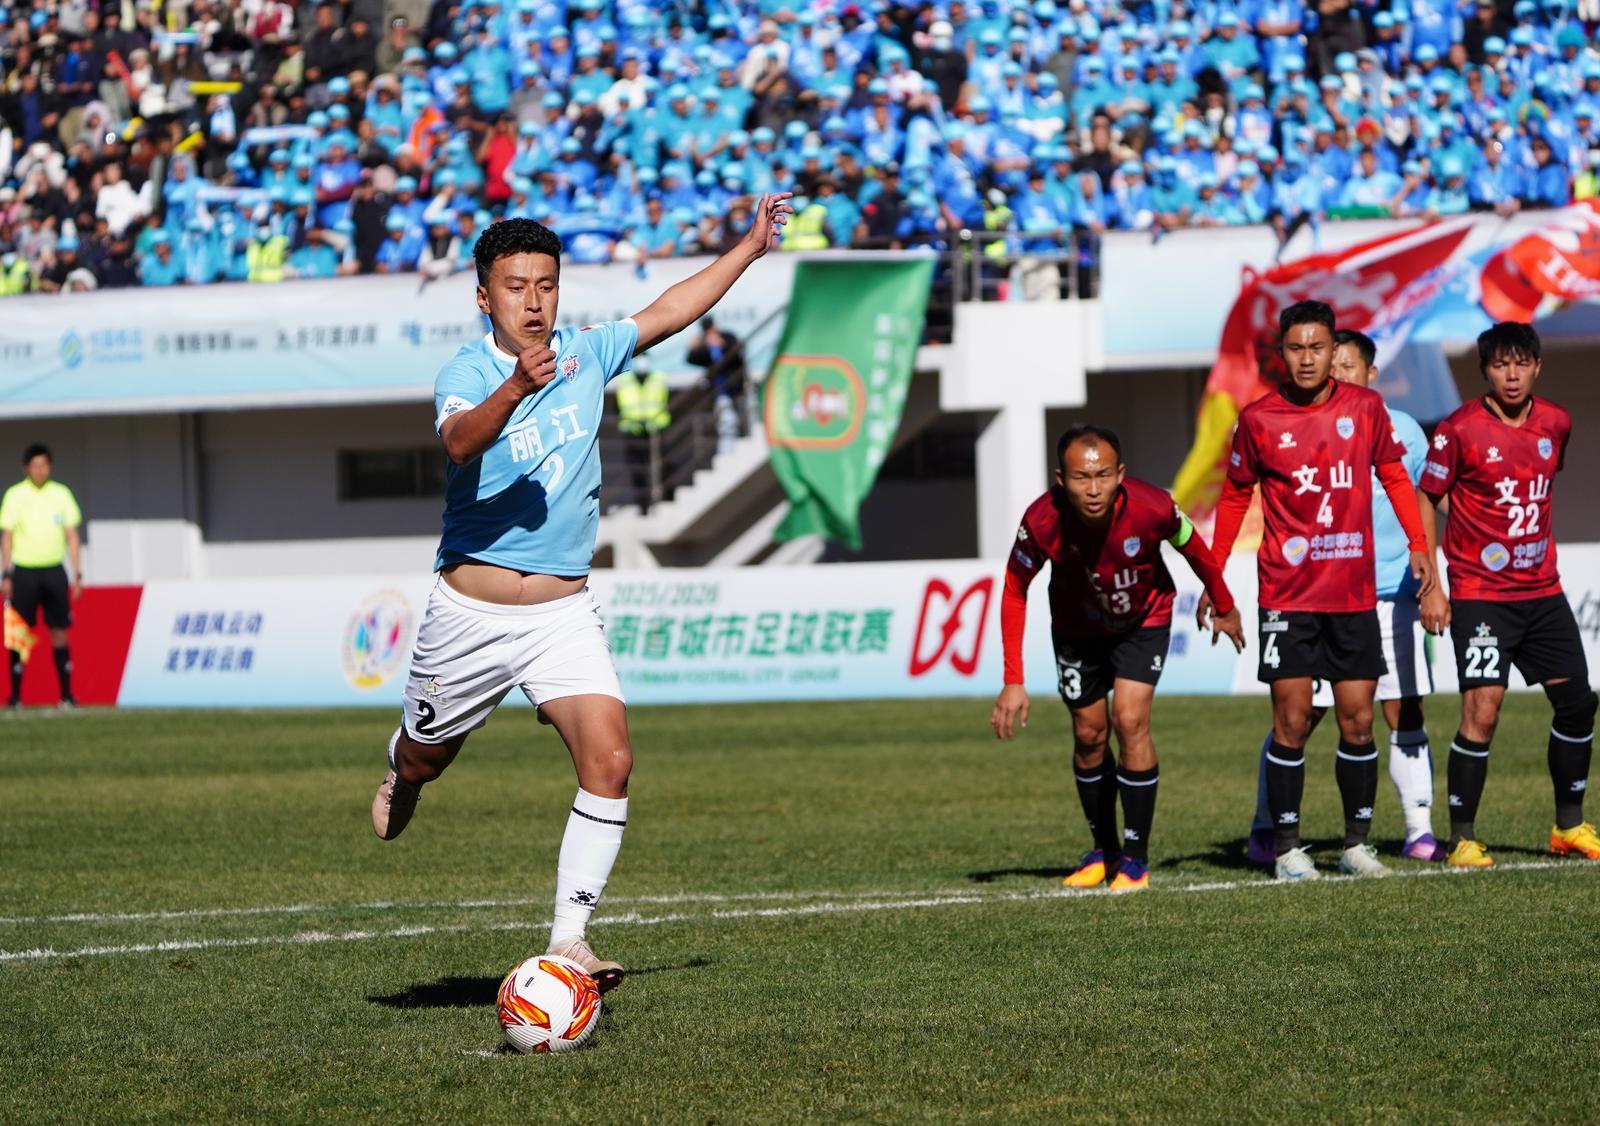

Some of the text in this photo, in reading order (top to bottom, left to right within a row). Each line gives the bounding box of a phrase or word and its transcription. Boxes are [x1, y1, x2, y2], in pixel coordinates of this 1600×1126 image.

[505, 403, 588, 463] 丽江
[541, 452, 565, 492] 2
[1292, 460, 1352, 495] 文山
[1494, 474, 1549, 504] 文山
[1316, 492, 1334, 528] 4
[1507, 503, 1540, 537] 22
[600, 609, 894, 660] 南省城市足球联赛
[1264, 633, 1280, 669] 4
[1465, 646, 1499, 678] 22
[415, 700, 436, 736] 2
